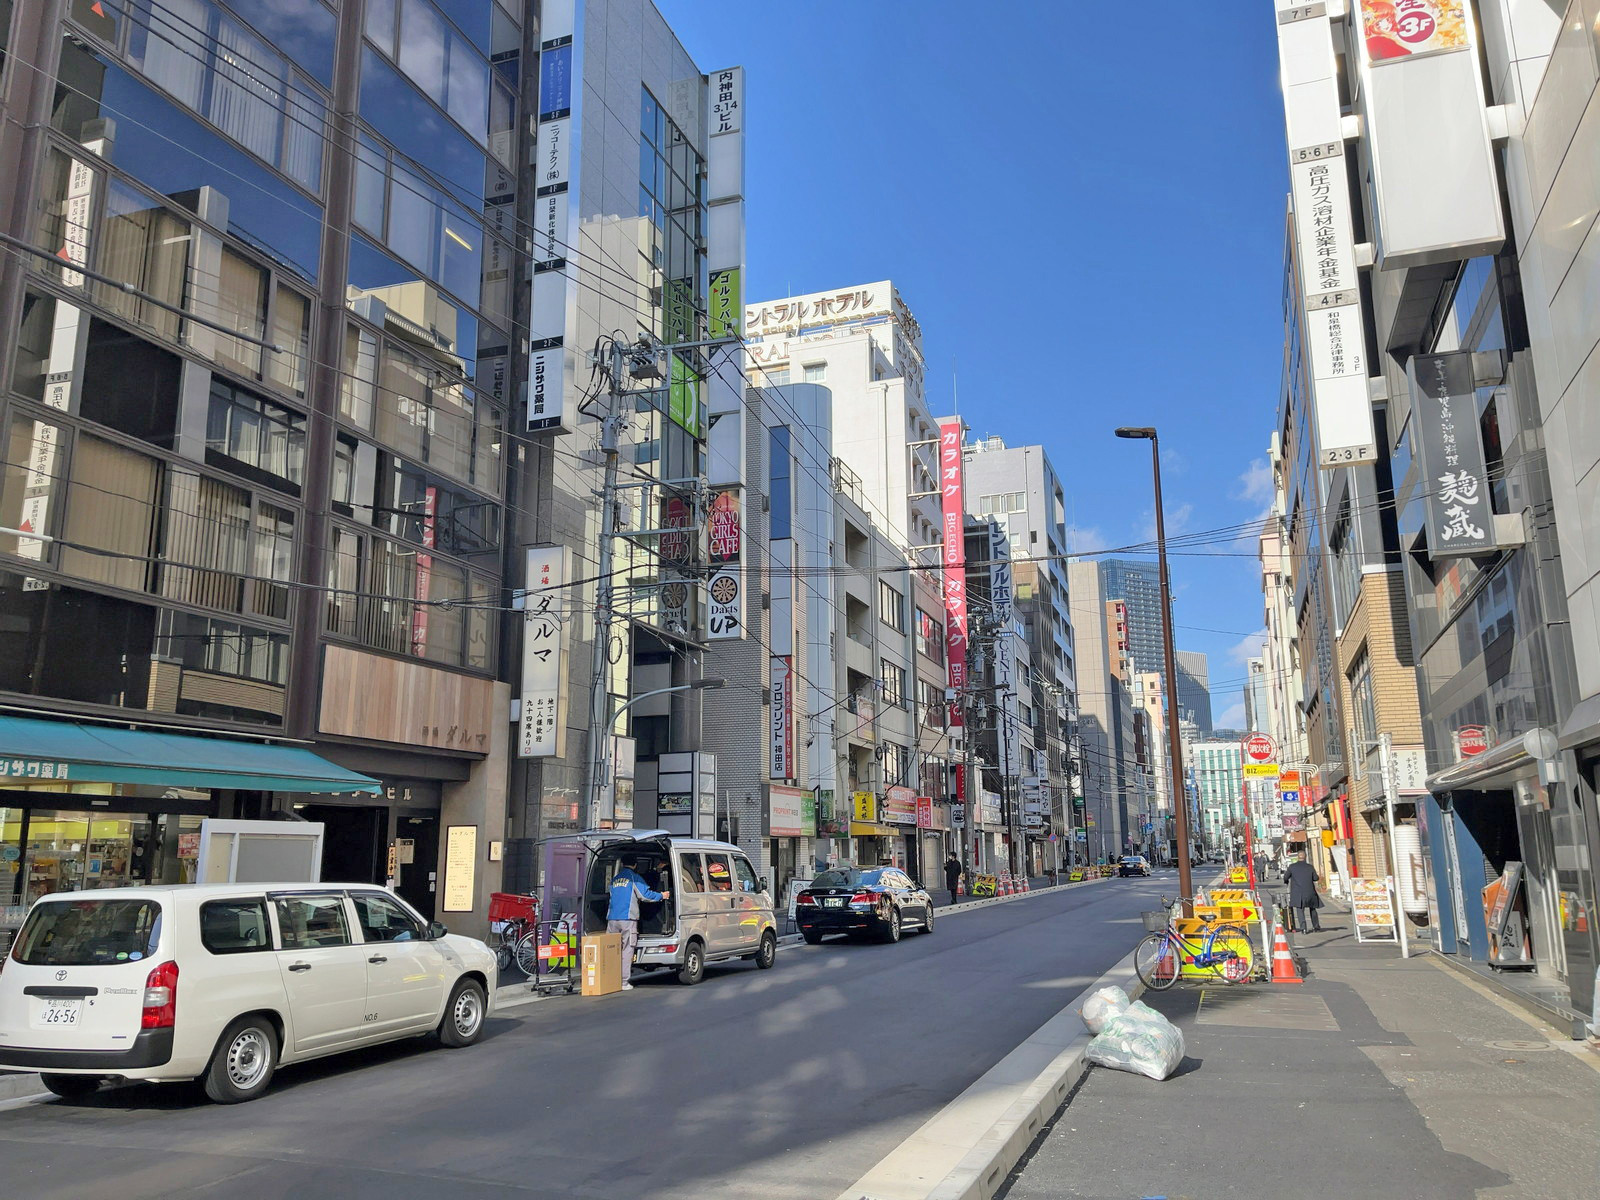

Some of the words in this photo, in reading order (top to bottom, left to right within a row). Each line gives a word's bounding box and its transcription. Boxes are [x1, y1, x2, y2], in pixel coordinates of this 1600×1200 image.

[1400, 17, 1432, 38] 3F
[813, 289, 876, 318] ホテル
[943, 431, 960, 498] カラオケ
[710, 524, 739, 540] GIRLS
[946, 512, 957, 532] BIG
[710, 539, 739, 556] CAFE
[711, 605, 738, 615] Darts
[948, 580, 964, 647] カラオケ
[533, 595, 555, 663] ダルマ
[710, 615, 738, 634] UP
[1249, 743, 1271, 754] 消火栓
